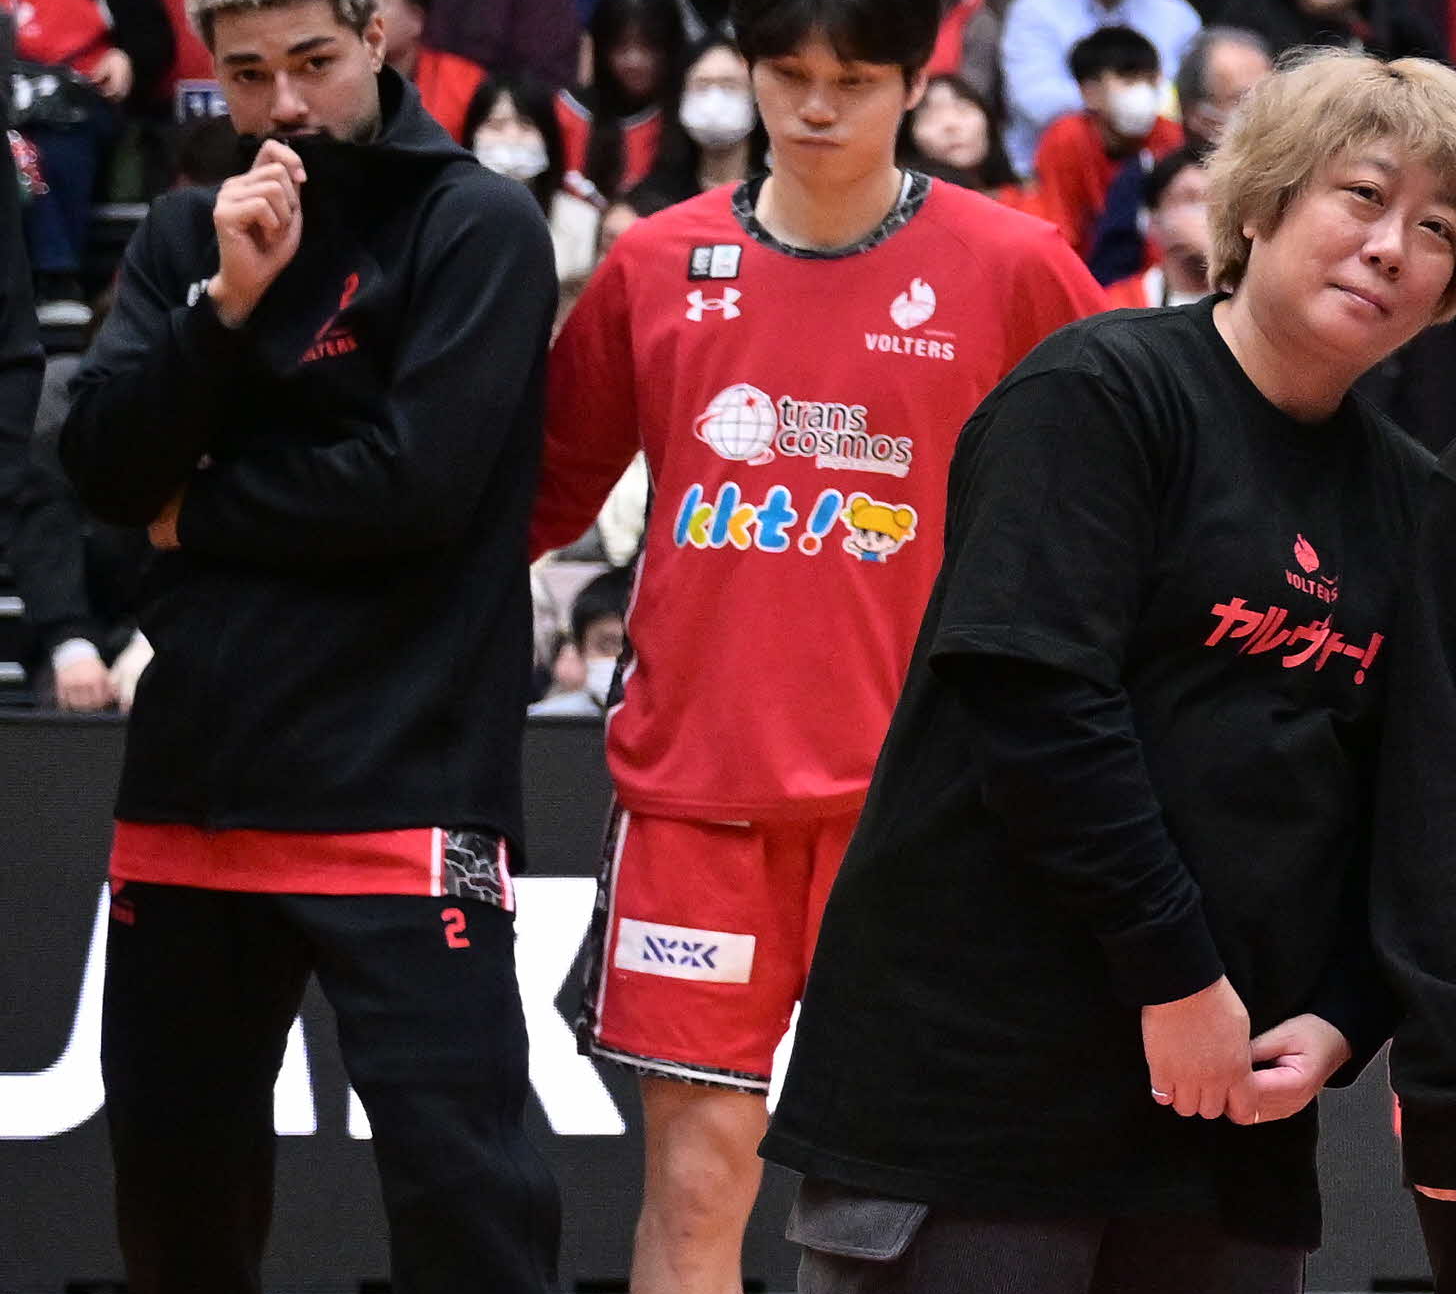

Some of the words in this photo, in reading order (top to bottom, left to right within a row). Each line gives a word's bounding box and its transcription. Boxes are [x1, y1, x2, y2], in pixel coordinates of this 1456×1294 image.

[864, 332, 956, 362] VOLTERS
[779, 396, 867, 432] trans
[777, 428, 913, 465] cosmos
[674, 481, 844, 555] kkt!
[1285, 569, 1339, 604] VOLTERS
[440, 907, 471, 949] 2
